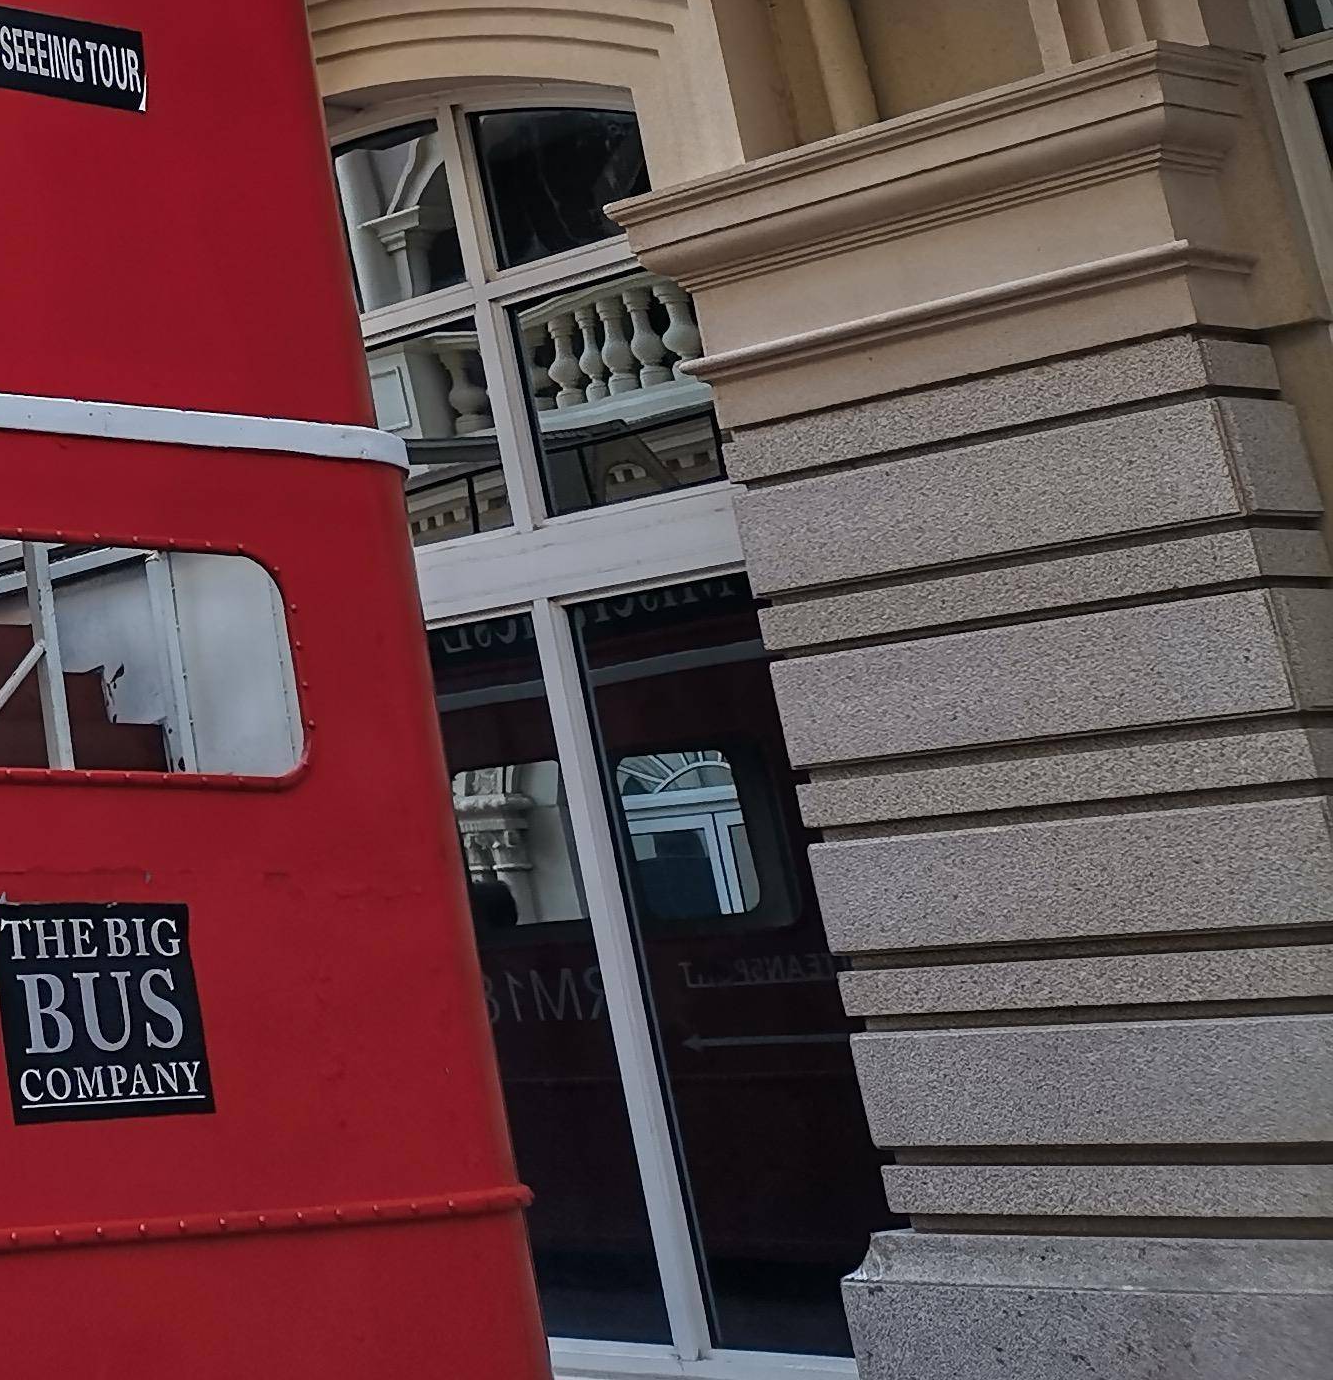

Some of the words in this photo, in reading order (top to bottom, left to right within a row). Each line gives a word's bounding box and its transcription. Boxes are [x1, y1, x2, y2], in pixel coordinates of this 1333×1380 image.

[85, 41, 143, 93] TOUR
[0, 917, 98, 960] THE
[103, 917, 182, 957] BIG
[16, 968, 184, 1054] BUS
[20, 1061, 201, 1102] COMPANY
